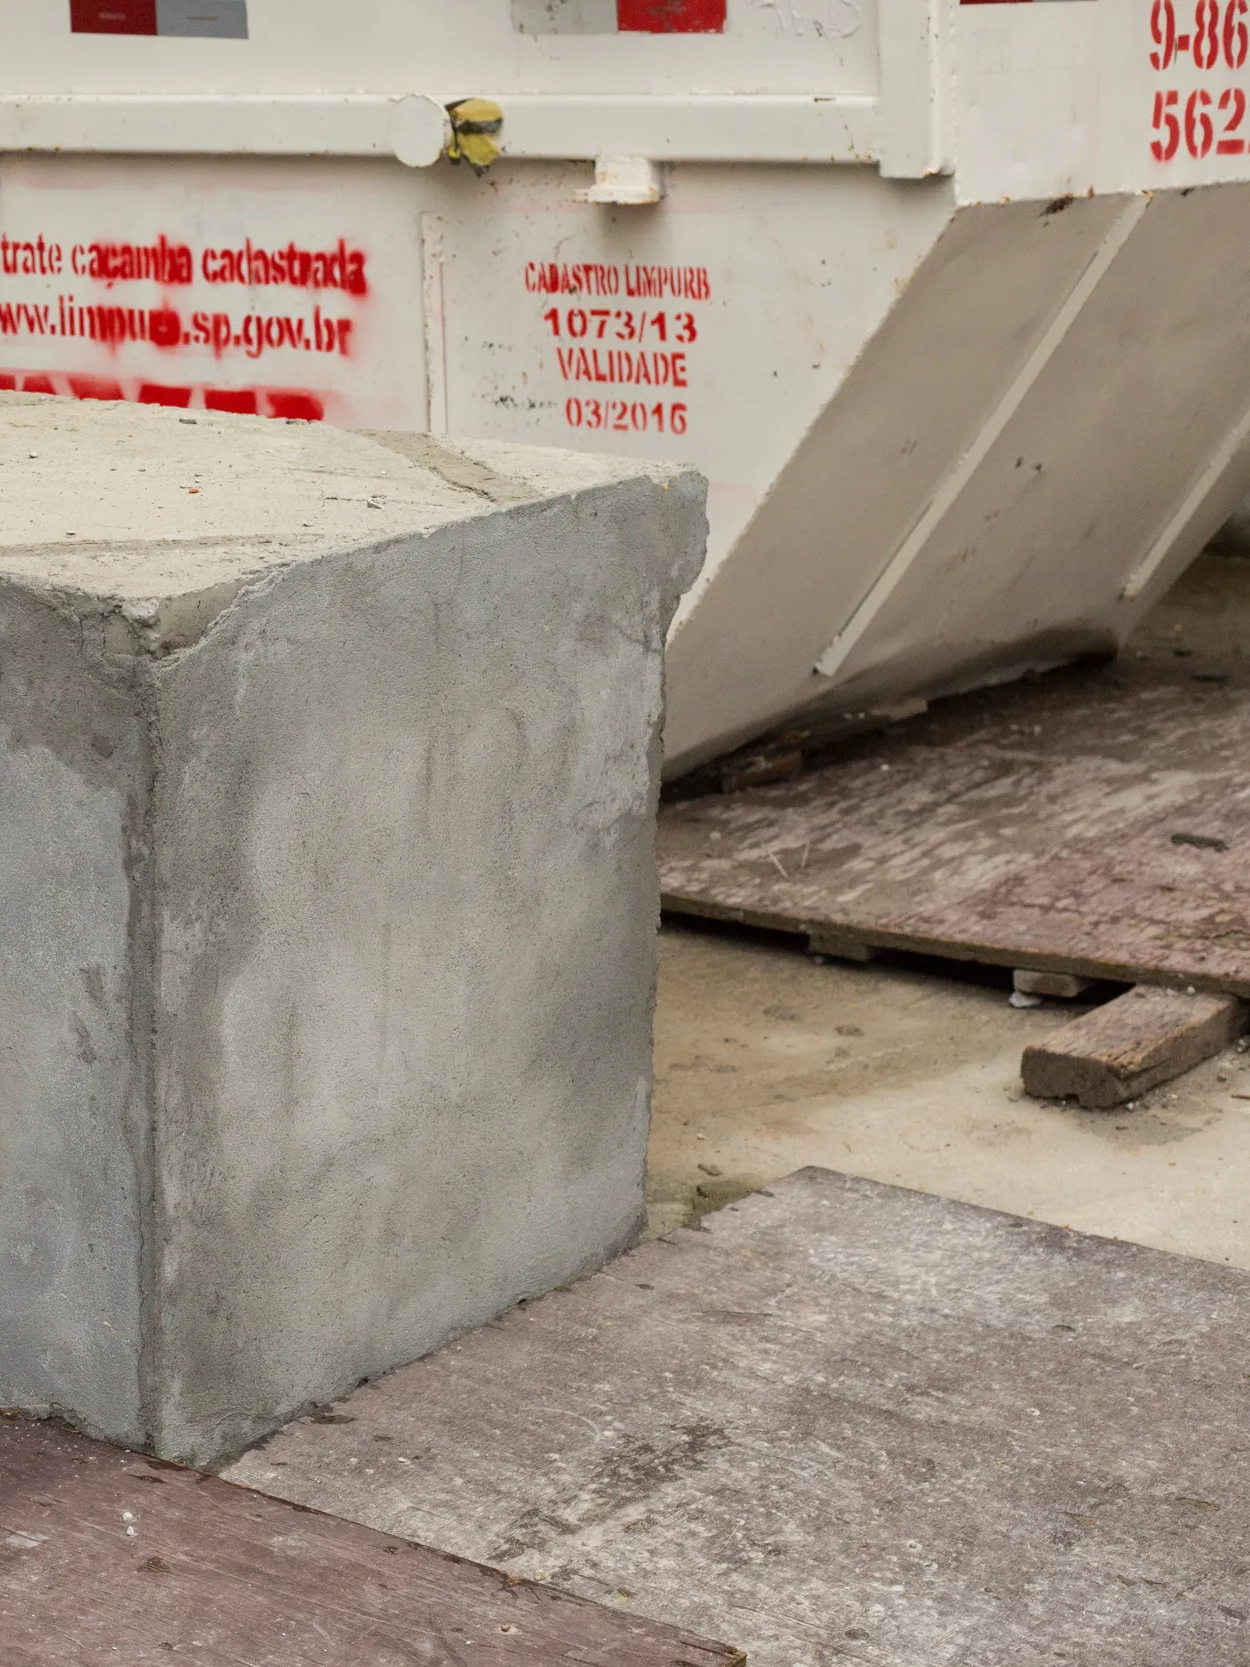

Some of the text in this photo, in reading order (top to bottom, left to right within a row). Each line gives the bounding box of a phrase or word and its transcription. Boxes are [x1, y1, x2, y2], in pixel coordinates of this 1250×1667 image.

[1150, 88, 1250, 163] 562
[71, 233, 192, 288] caçamba
[201, 236, 367, 296] cadastrada
[524, 261, 710, 300] CADASTRO LIMPURB
[543, 307, 698, 343] 1073/13
[556, 347, 688, 388] VALIDADE
[565, 398, 687, 435] 03/2016
